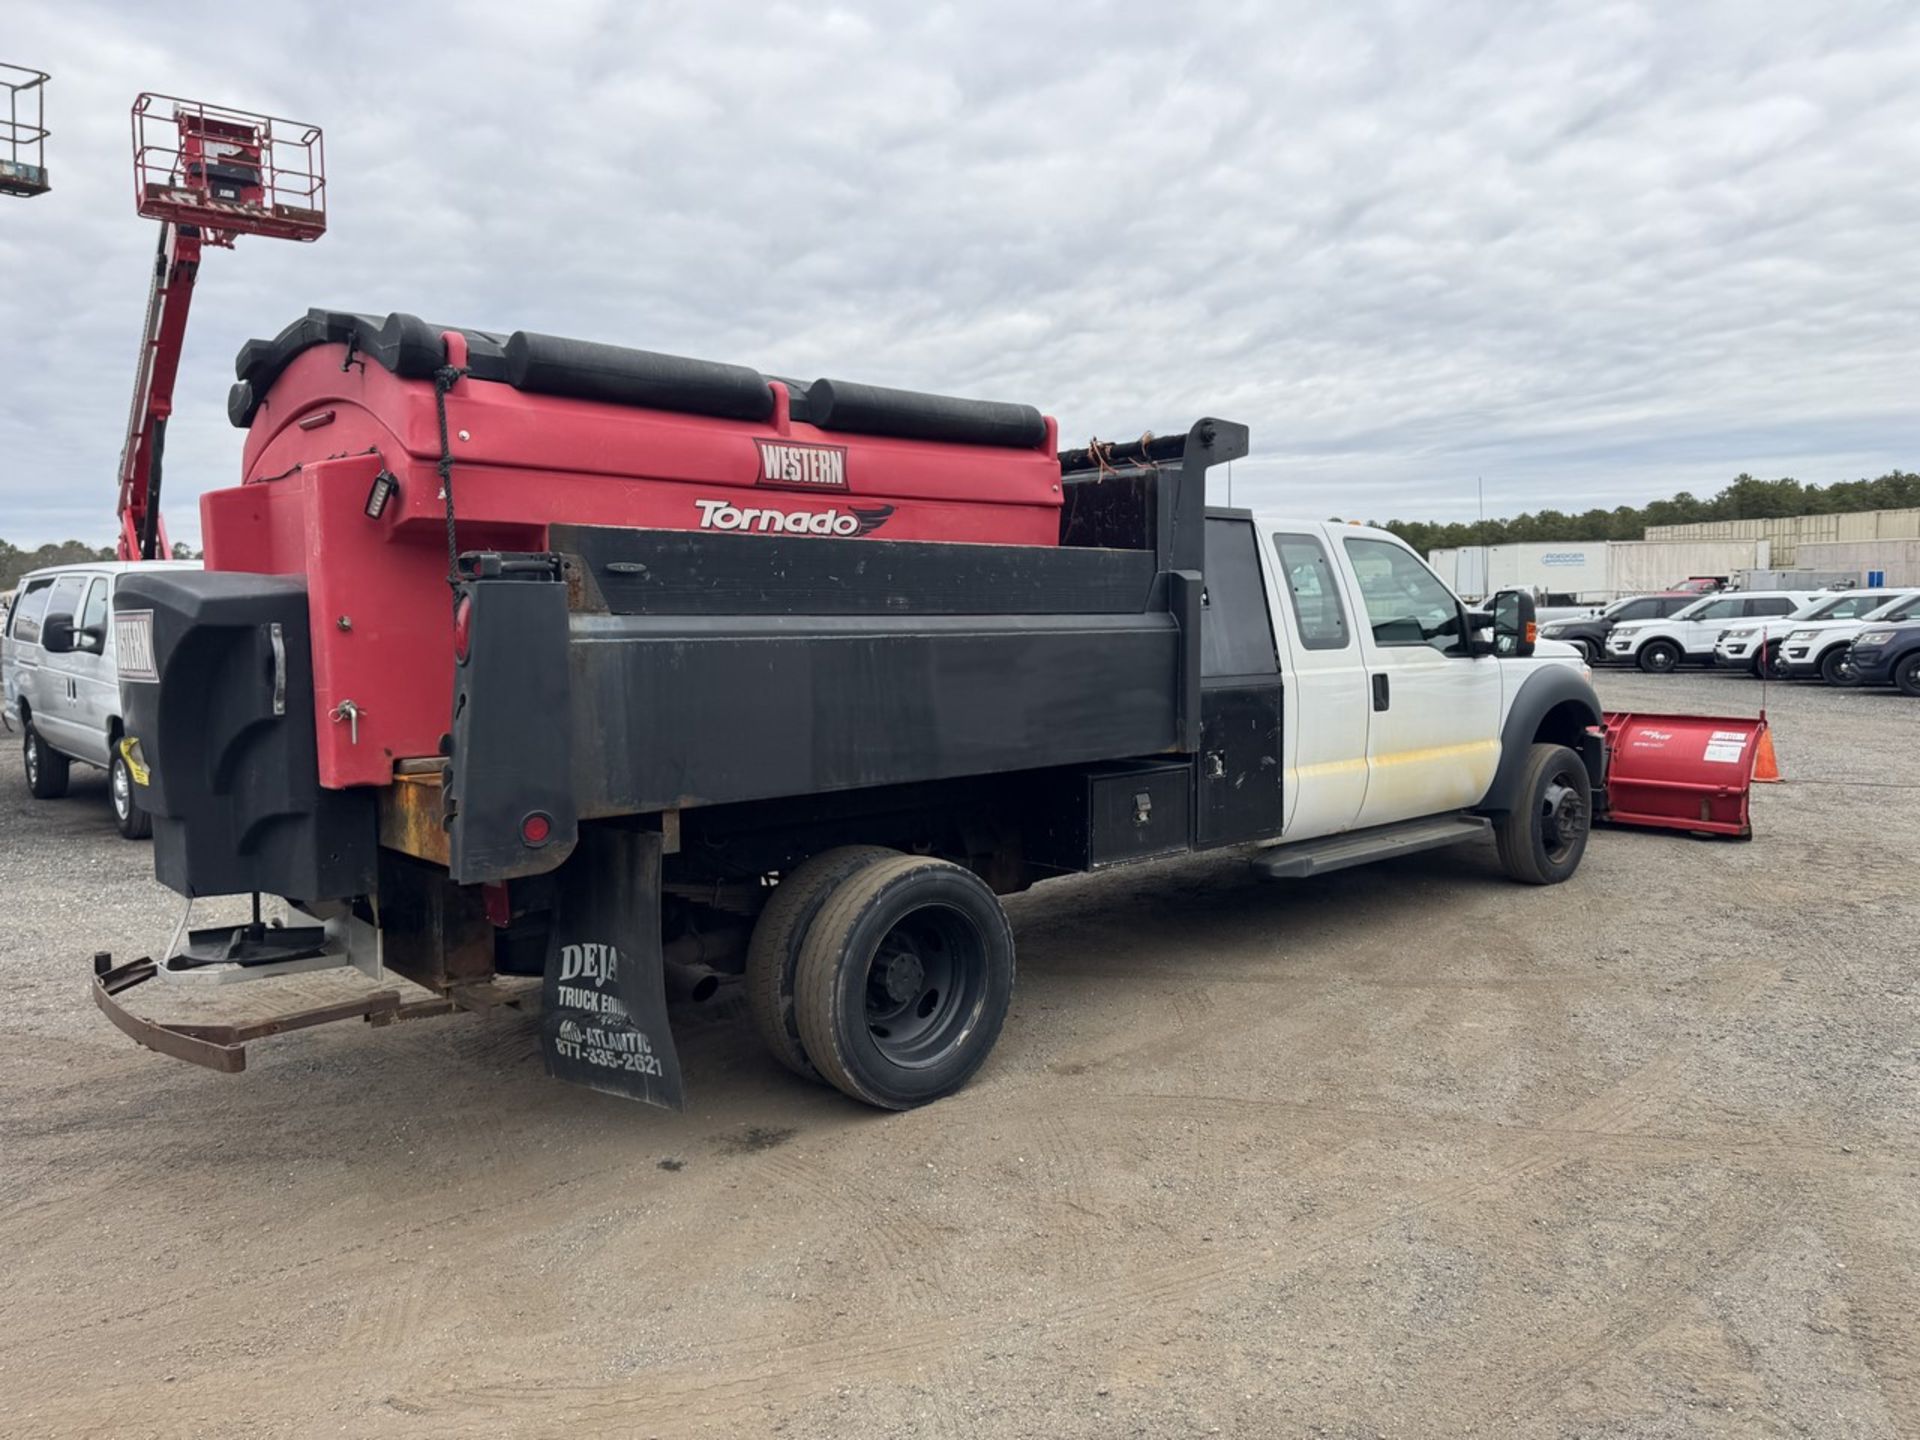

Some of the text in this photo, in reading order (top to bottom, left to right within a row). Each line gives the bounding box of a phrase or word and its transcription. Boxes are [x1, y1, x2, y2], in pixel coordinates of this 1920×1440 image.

[761, 444, 843, 484] WESTERN
[695, 499, 859, 536] Tornado
[558, 986, 599, 1013] TRUCK
